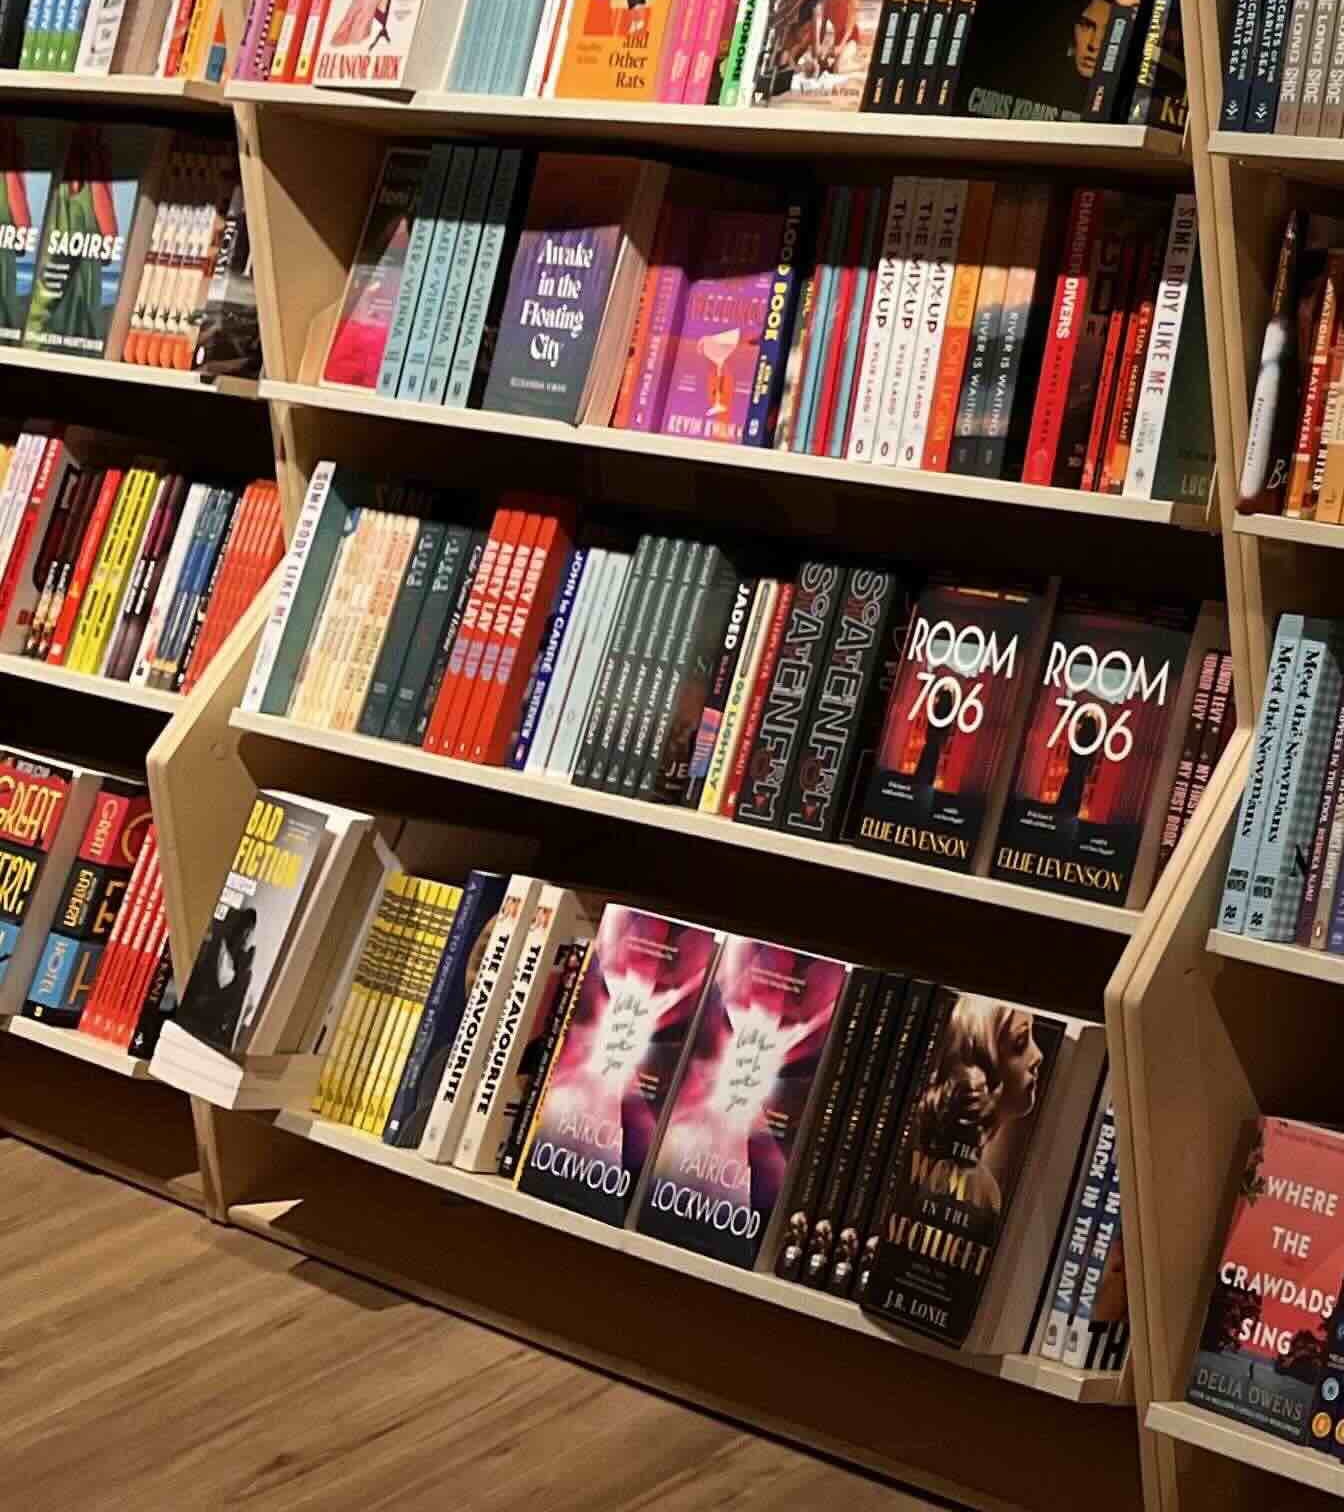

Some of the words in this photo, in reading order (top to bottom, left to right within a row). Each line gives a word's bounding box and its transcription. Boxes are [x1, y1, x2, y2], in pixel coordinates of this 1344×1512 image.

[47, 229, 122, 261] SAOIRSE
[537, 241, 594, 268] Awake
[560, 274, 582, 300] the
[519, 302, 583, 336] Floating
[531, 333, 563, 367] City
[1044, 641, 1169, 706] ROOM
[1048, 699, 1132, 761] 706
[246, 796, 284, 841] BAD
[998, 848, 1033, 873] ELLIE
[1037, 855, 1121, 891] LEVENSON
[650, 1179, 760, 1240] LOCKWOOD
[1268, 1176, 1338, 1217] WHERE
[1272, 1226, 1309, 1258] THE
[1221, 1262, 1334, 1319] CRAWDADS
[1239, 1316, 1291, 1355] SING
